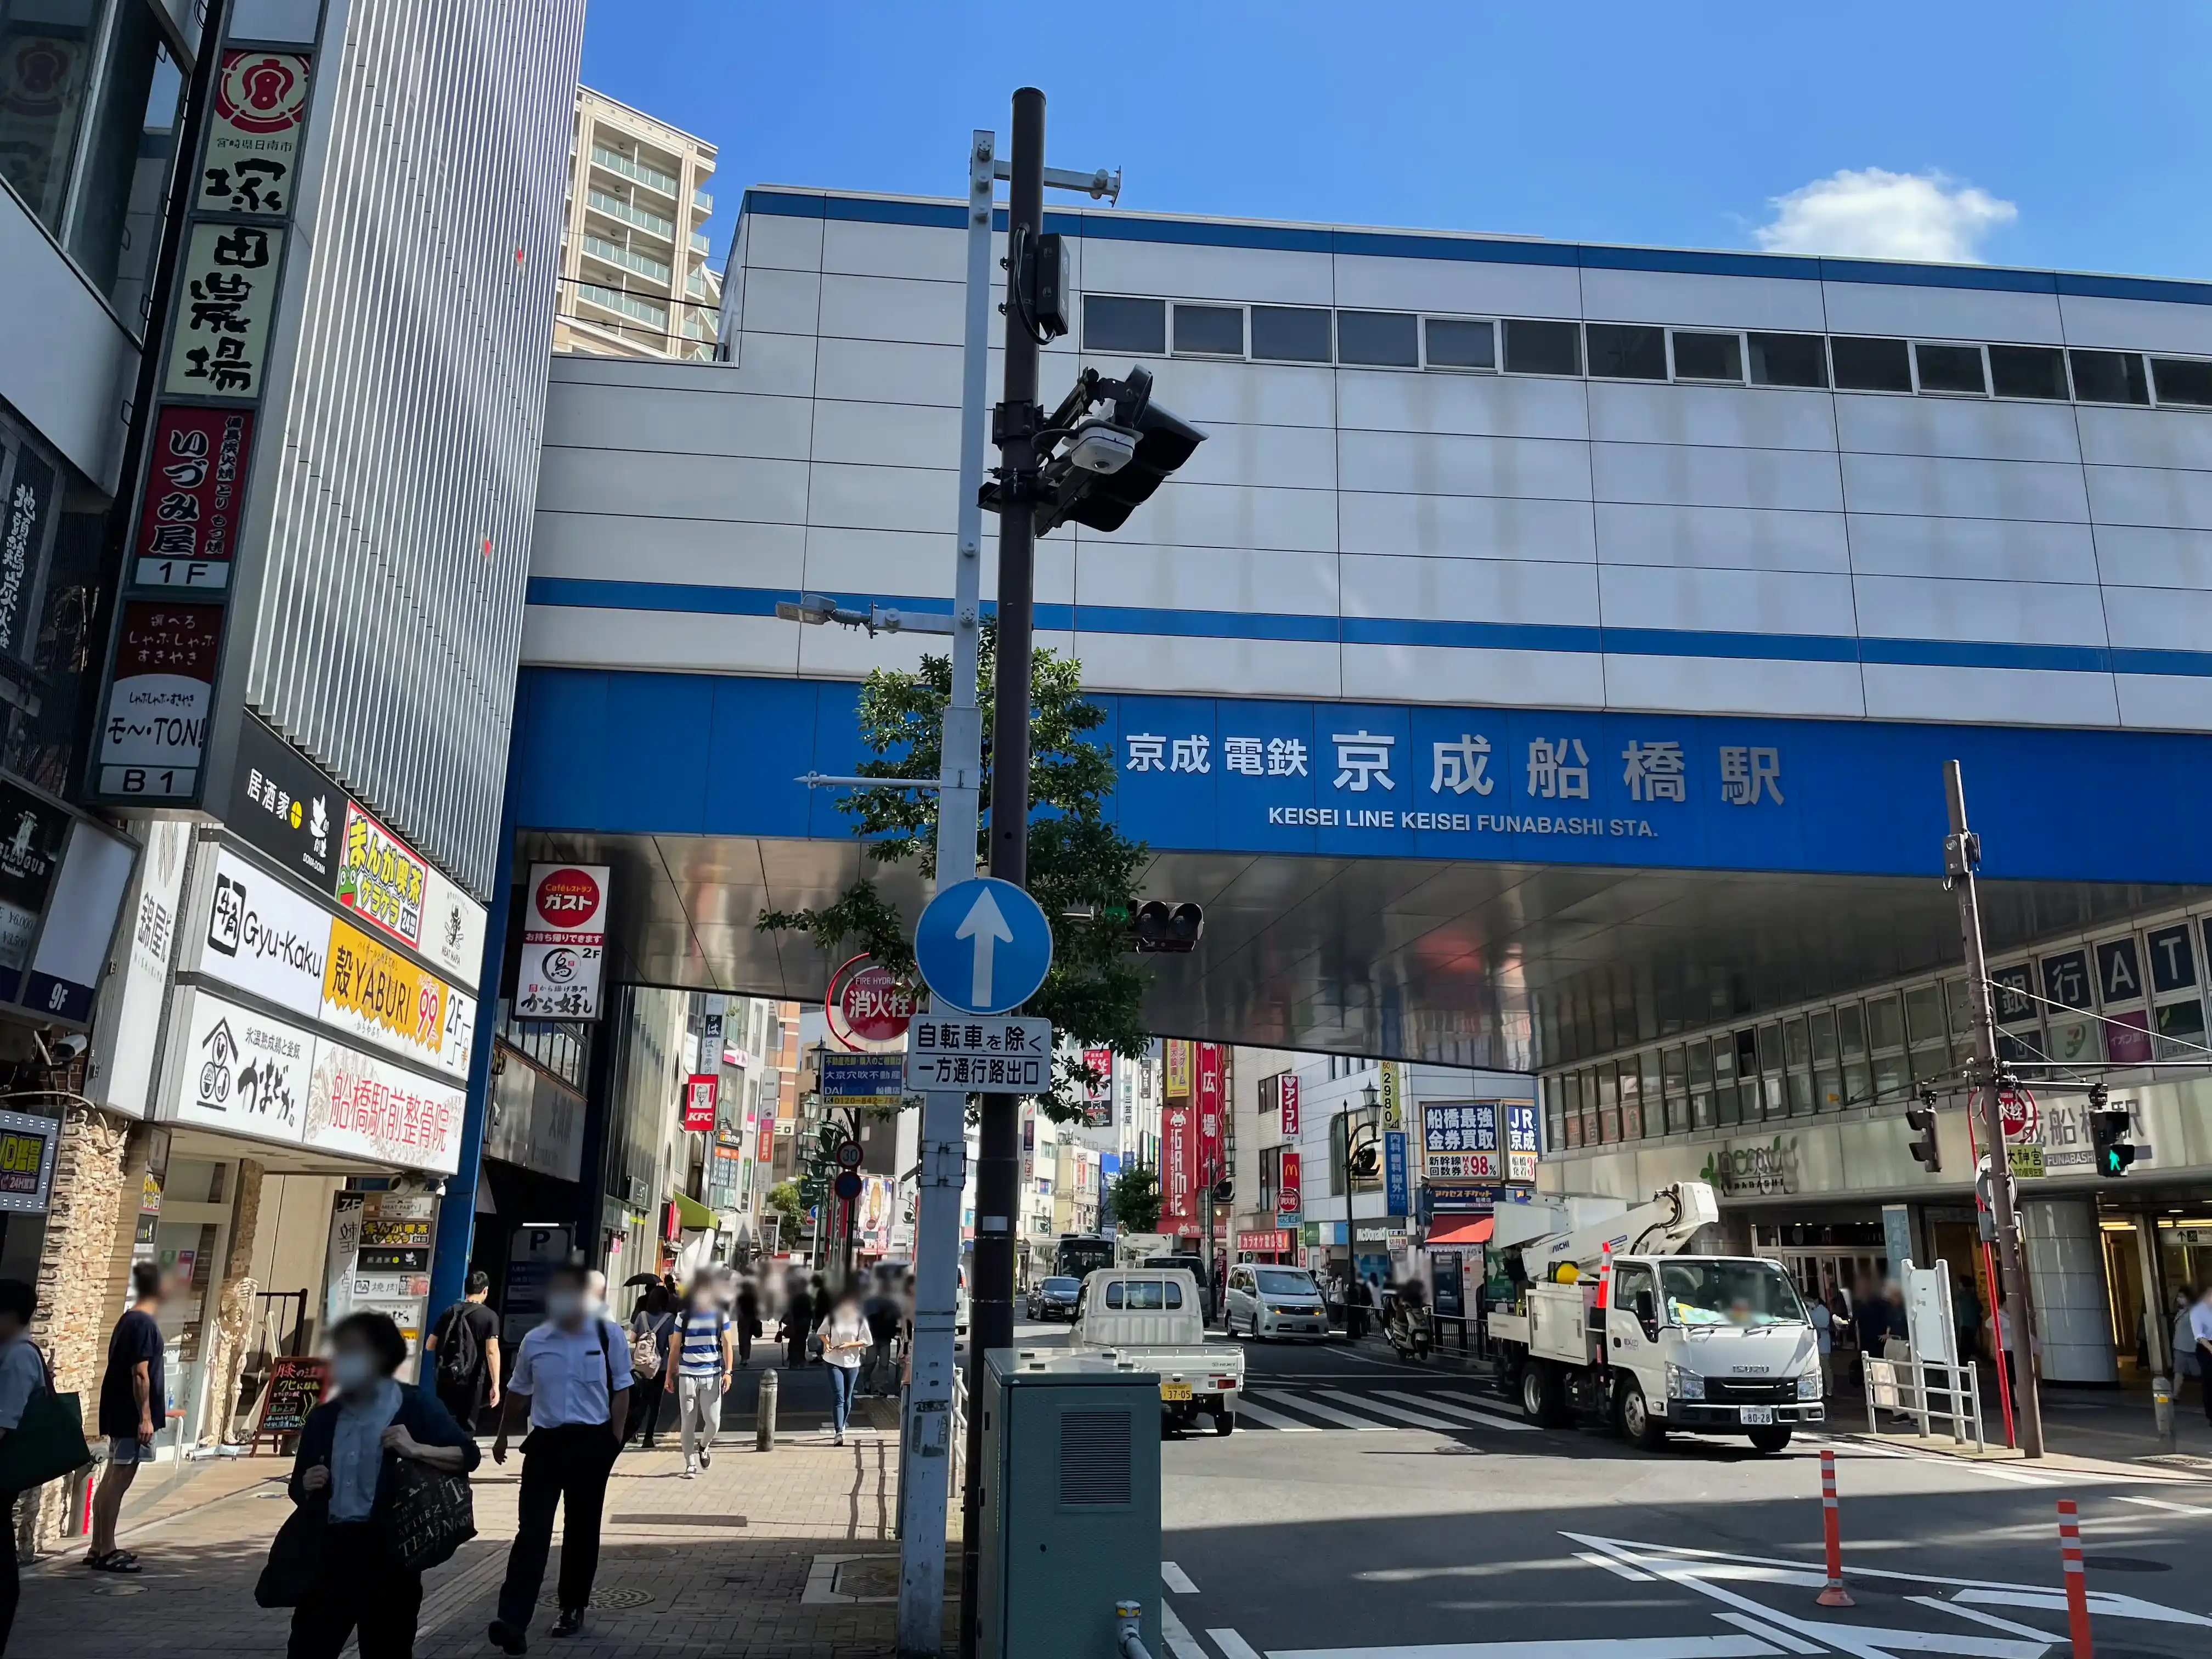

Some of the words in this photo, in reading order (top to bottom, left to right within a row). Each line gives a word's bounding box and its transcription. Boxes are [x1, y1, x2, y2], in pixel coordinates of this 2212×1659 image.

[151, 430, 209, 555] いづみ屋
[159, 563, 208, 583] 1F
[129, 631, 215, 648] しゃぶしゃぶ
[138, 650, 197, 665] すきやき
[1125, 732, 1308, 777] 京成電鉄
[1331, 729, 1785, 806] 京成船橋駅
[1268, 806, 1340, 827] KEISEI
[1344, 809, 1395, 829] LINE
[1401, 811, 1471, 832] KEISEI
[1476, 814, 1604, 836] FUNABASHI
[1610, 819, 1658, 838] STA.
[349, 814, 422, 912] まんが喫茶
[360, 873, 400, 928] ゲラゲラ
[545, 894, 592, 911] ガスト
[244, 911, 321, 979] Gyu-Kaku
[526, 933, 601, 944] お持ち帰りできます
[582, 949, 600, 958] 2F
[49, 983, 69, 1009] 9F
[355, 957, 411, 1025] YABURI
[416, 989, 438, 1039] 99
[521, 993, 592, 1015] から好し
[918, 1023, 1041, 1052] 自転車を除く
[825, 1071, 901, 1080] 大京穴吹不動産
[918, 1057, 1039, 1085] 一方通行路出口
[329, 1068, 449, 1152] 船橋駅前整骨院
[687, 1113, 713, 1121] KFC
[1284, 1088, 1296, 1132] アイフル
[1427, 1107, 1493, 1129] 船橋最強
[1428, 1130, 1494, 1150] 金券買取
[1510, 1130, 1536, 1151] 京成
[843, 1149, 857, 1161] 30
[1429, 1156, 1461, 1166] 新幹線
[1471, 1155, 1488, 1175] 98
[1175, 1128, 1187, 1216] GAME
[1430, 1167, 1462, 1176] 回数券
[1732, 1364, 1770, 1373] ISUZU
[1167, 1390, 1191, 1399] 37-05
[1747, 1413, 1770, 1423] 80-28
